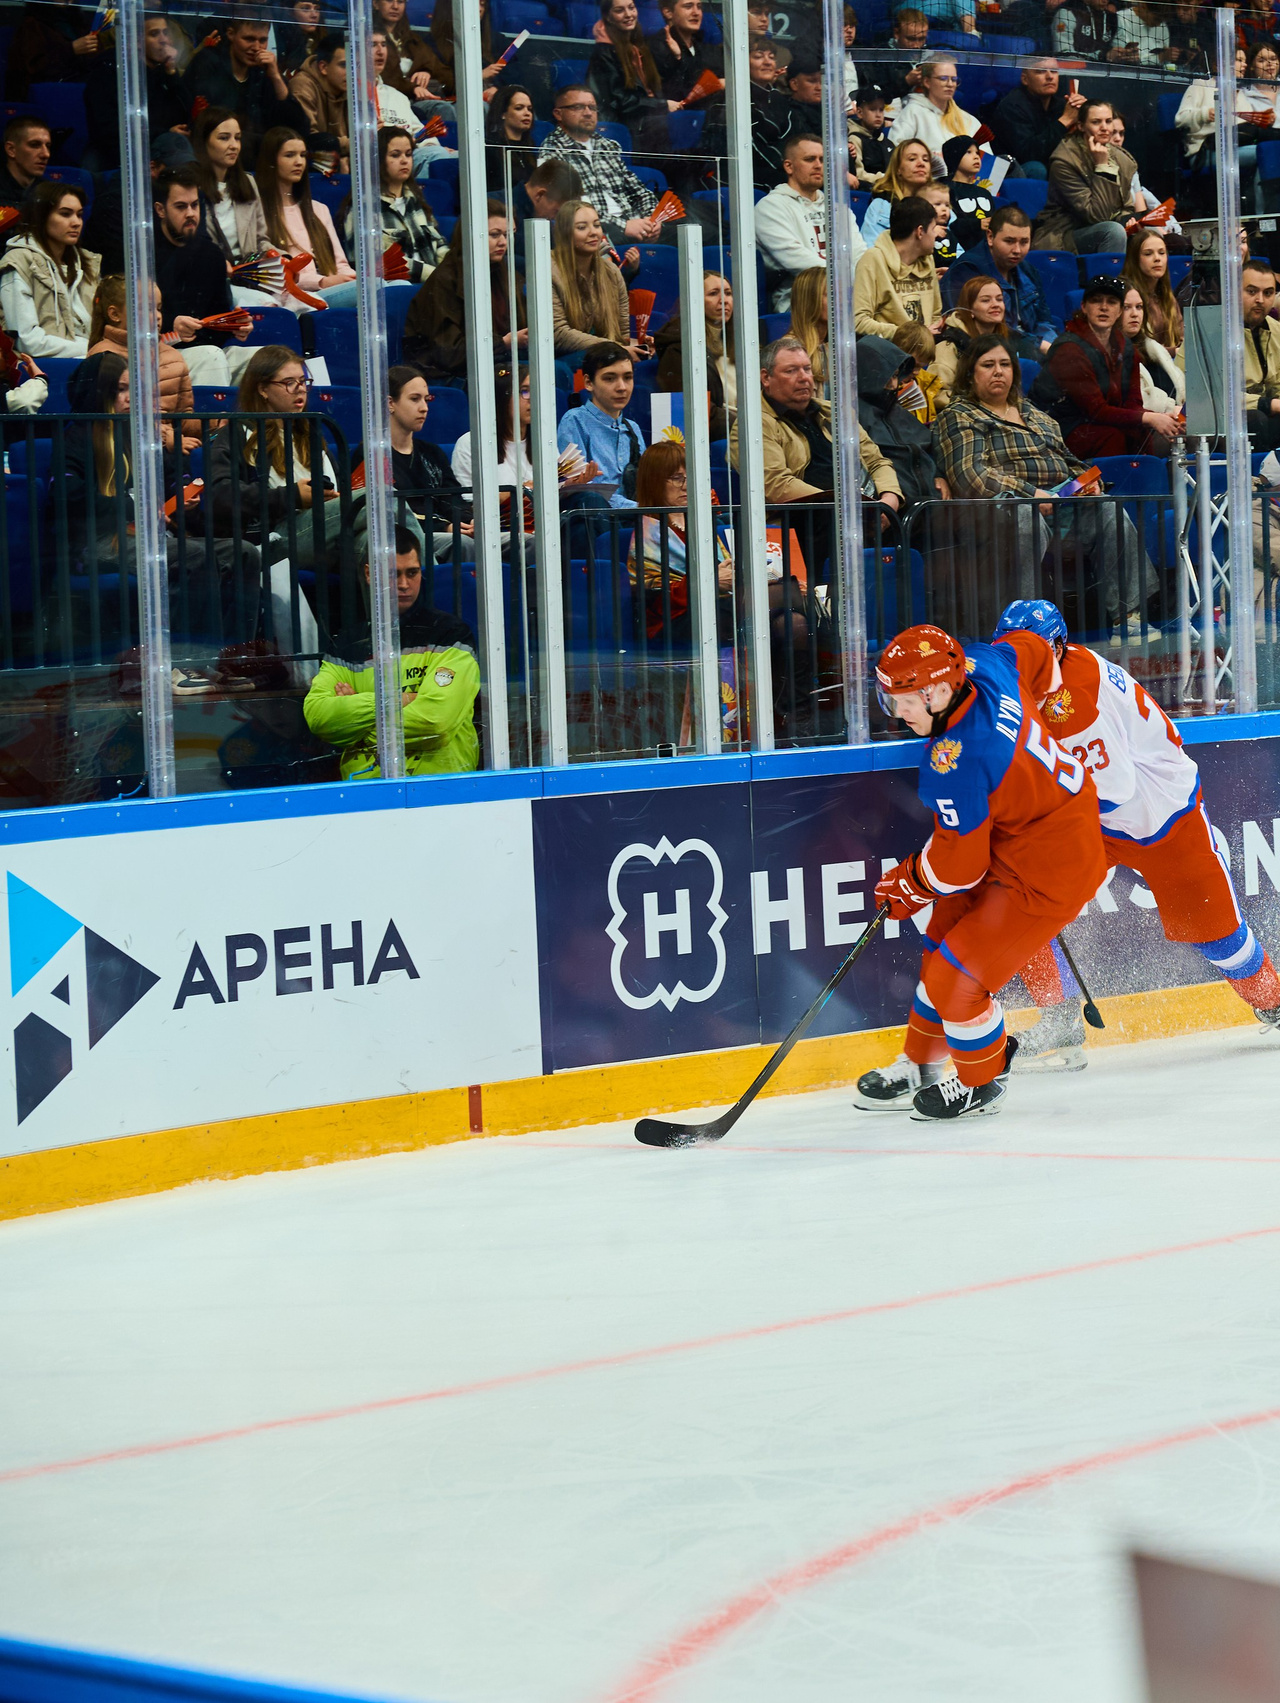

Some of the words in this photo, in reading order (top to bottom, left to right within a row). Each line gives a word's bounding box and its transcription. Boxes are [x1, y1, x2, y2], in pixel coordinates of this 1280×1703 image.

[995, 694, 1022, 743] ILYIN
[1025, 718, 1086, 796] 5
[1071, 738, 1110, 774] 23
[936, 799, 960, 827] 5
[643, 889, 692, 959] H
[173, 918, 421, 1010] АРЕНА
